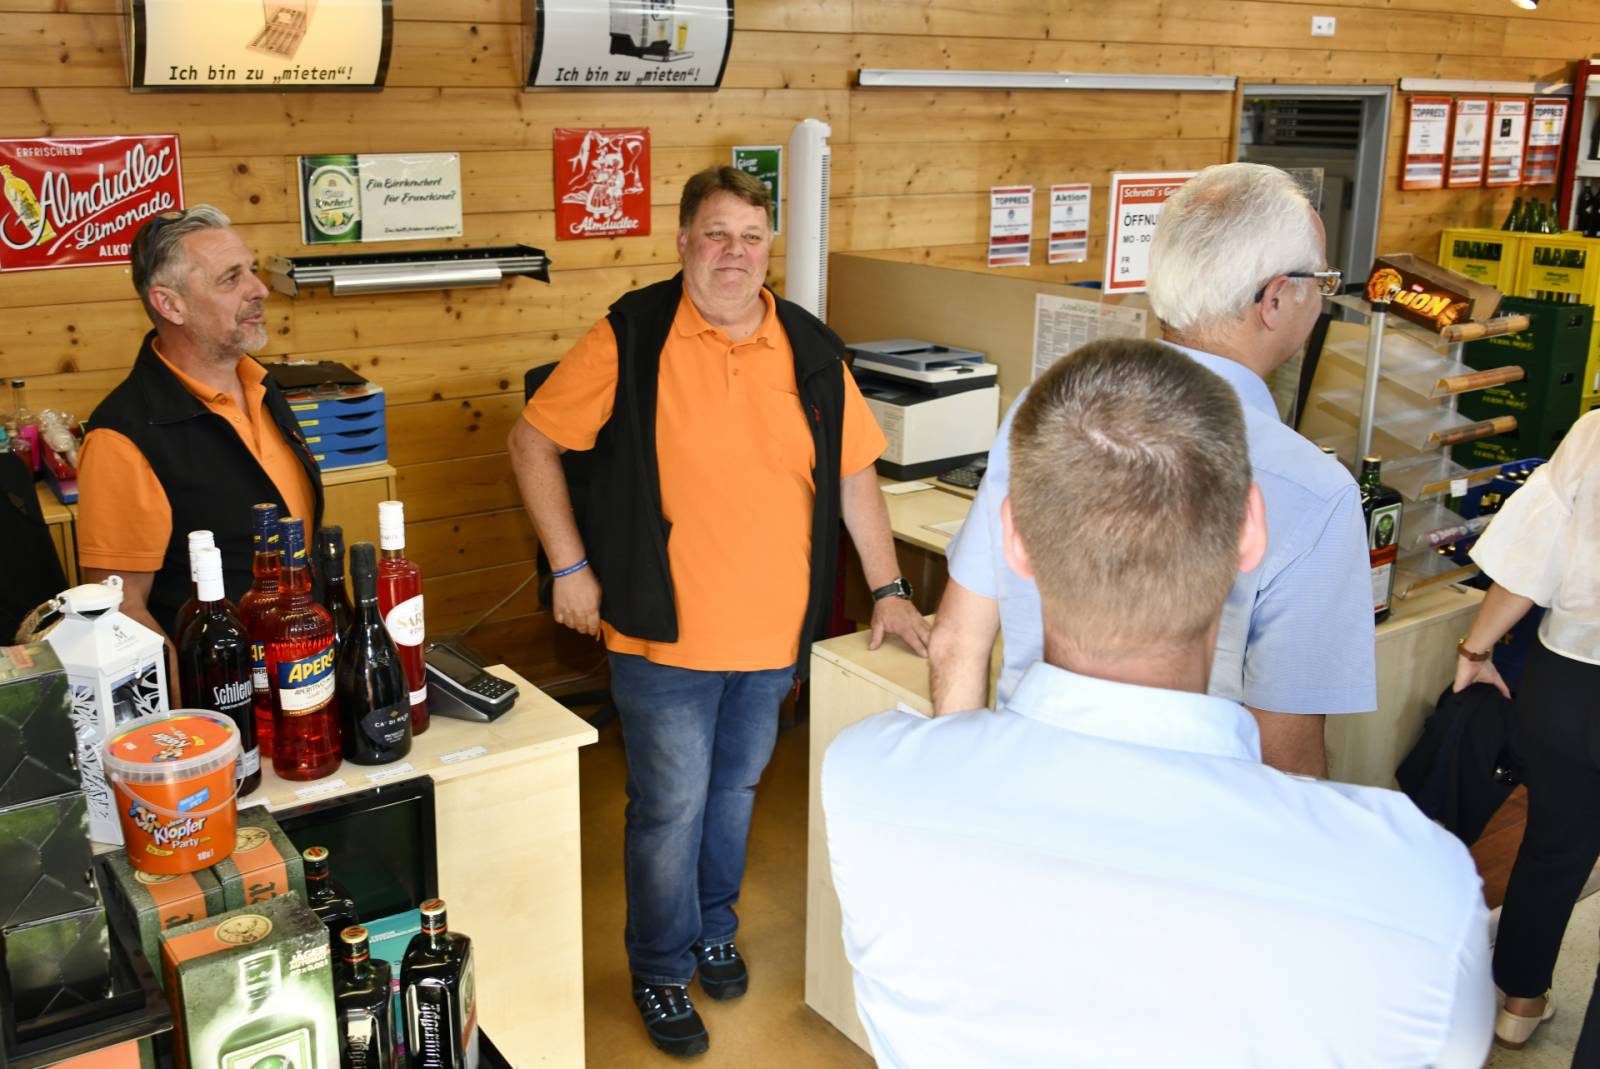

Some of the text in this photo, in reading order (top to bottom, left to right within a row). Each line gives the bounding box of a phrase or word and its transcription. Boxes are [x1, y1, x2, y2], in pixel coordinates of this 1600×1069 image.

[169, 65, 198, 81] Ich
[208, 64, 236, 81] bin
[245, 67, 264, 81] zu
[555, 67, 579, 81] Ich
[585, 66, 608, 81] bin
[615, 69, 631, 81] zu
[1412, 107, 1446, 118] TOPPREIS
[16, 147, 83, 158] ERFRISCHEND
[1, 144, 174, 250] Almdudler
[995, 195, 1029, 205] TOPPREIS
[1055, 193, 1087, 202] Aktion
[75, 191, 175, 250] Limonade
[570, 216, 639, 234] Almdudler
[1123, 235, 1135, 243] MO
[1140, 234, 1152, 243] DO
[99, 245, 132, 257] ALKO
[1394, 290, 1452, 316] LION
[154, 817, 206, 846] Klopfer
[171, 837, 200, 849] Party
